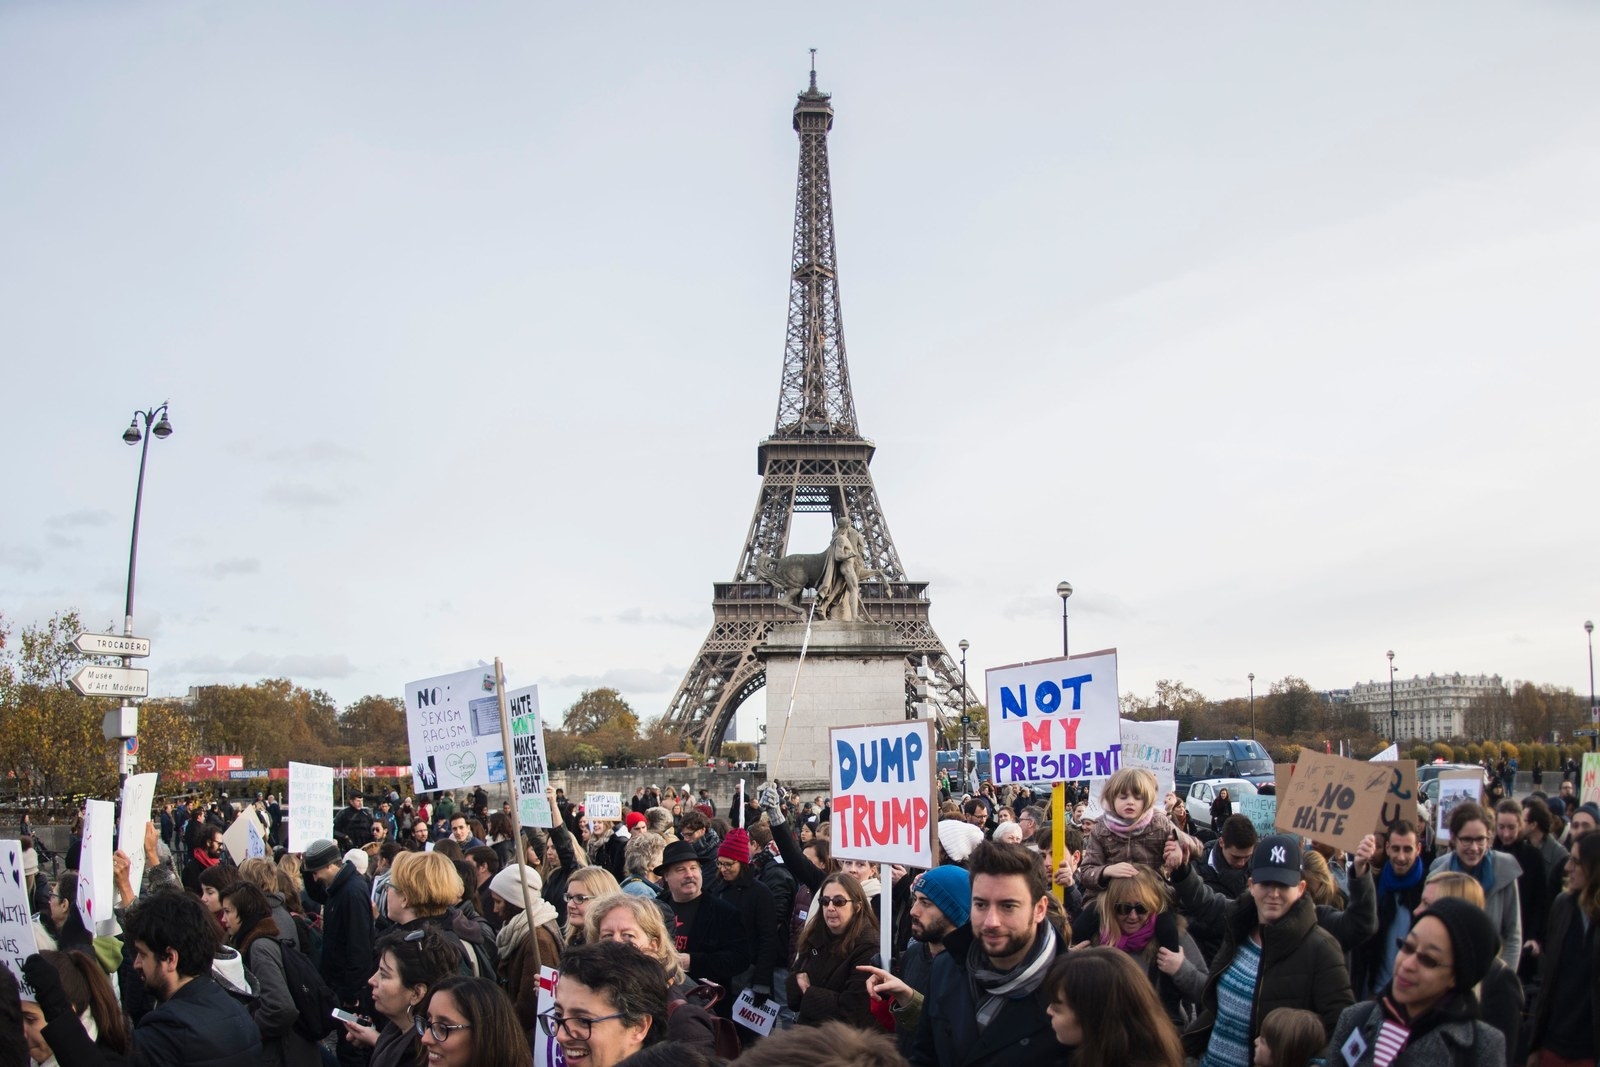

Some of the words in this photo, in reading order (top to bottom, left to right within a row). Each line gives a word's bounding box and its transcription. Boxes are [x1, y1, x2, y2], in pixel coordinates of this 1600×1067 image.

[97, 640, 147, 651] TROCADÉRO
[88, 671, 112, 680] Musée
[88, 682, 108, 691] d'Art
[113, 684, 145, 692] Moderne
[1000, 674, 1092, 719] NOT
[511, 695, 532, 717] HATE
[421, 710, 461, 726] SEXISM
[424, 725, 466, 743] RACISM
[1022, 718, 1081, 752] MY
[426, 738, 478, 755] HOMOPHOBIA
[514, 735, 537, 756] MAKE
[515, 756, 544, 775] AMERICA
[837, 732, 922, 790] DUMP
[994, 744, 1121, 783] PRESIDENT
[1240, 797, 1276, 811] WHOEVE
[1317, 782, 1355, 810] NO
[589, 804, 599, 816] KILL
[834, 795, 928, 852] TRUMP
[1292, 806, 1349, 835] HATE
[739, 1007, 765, 1026] NASTY
